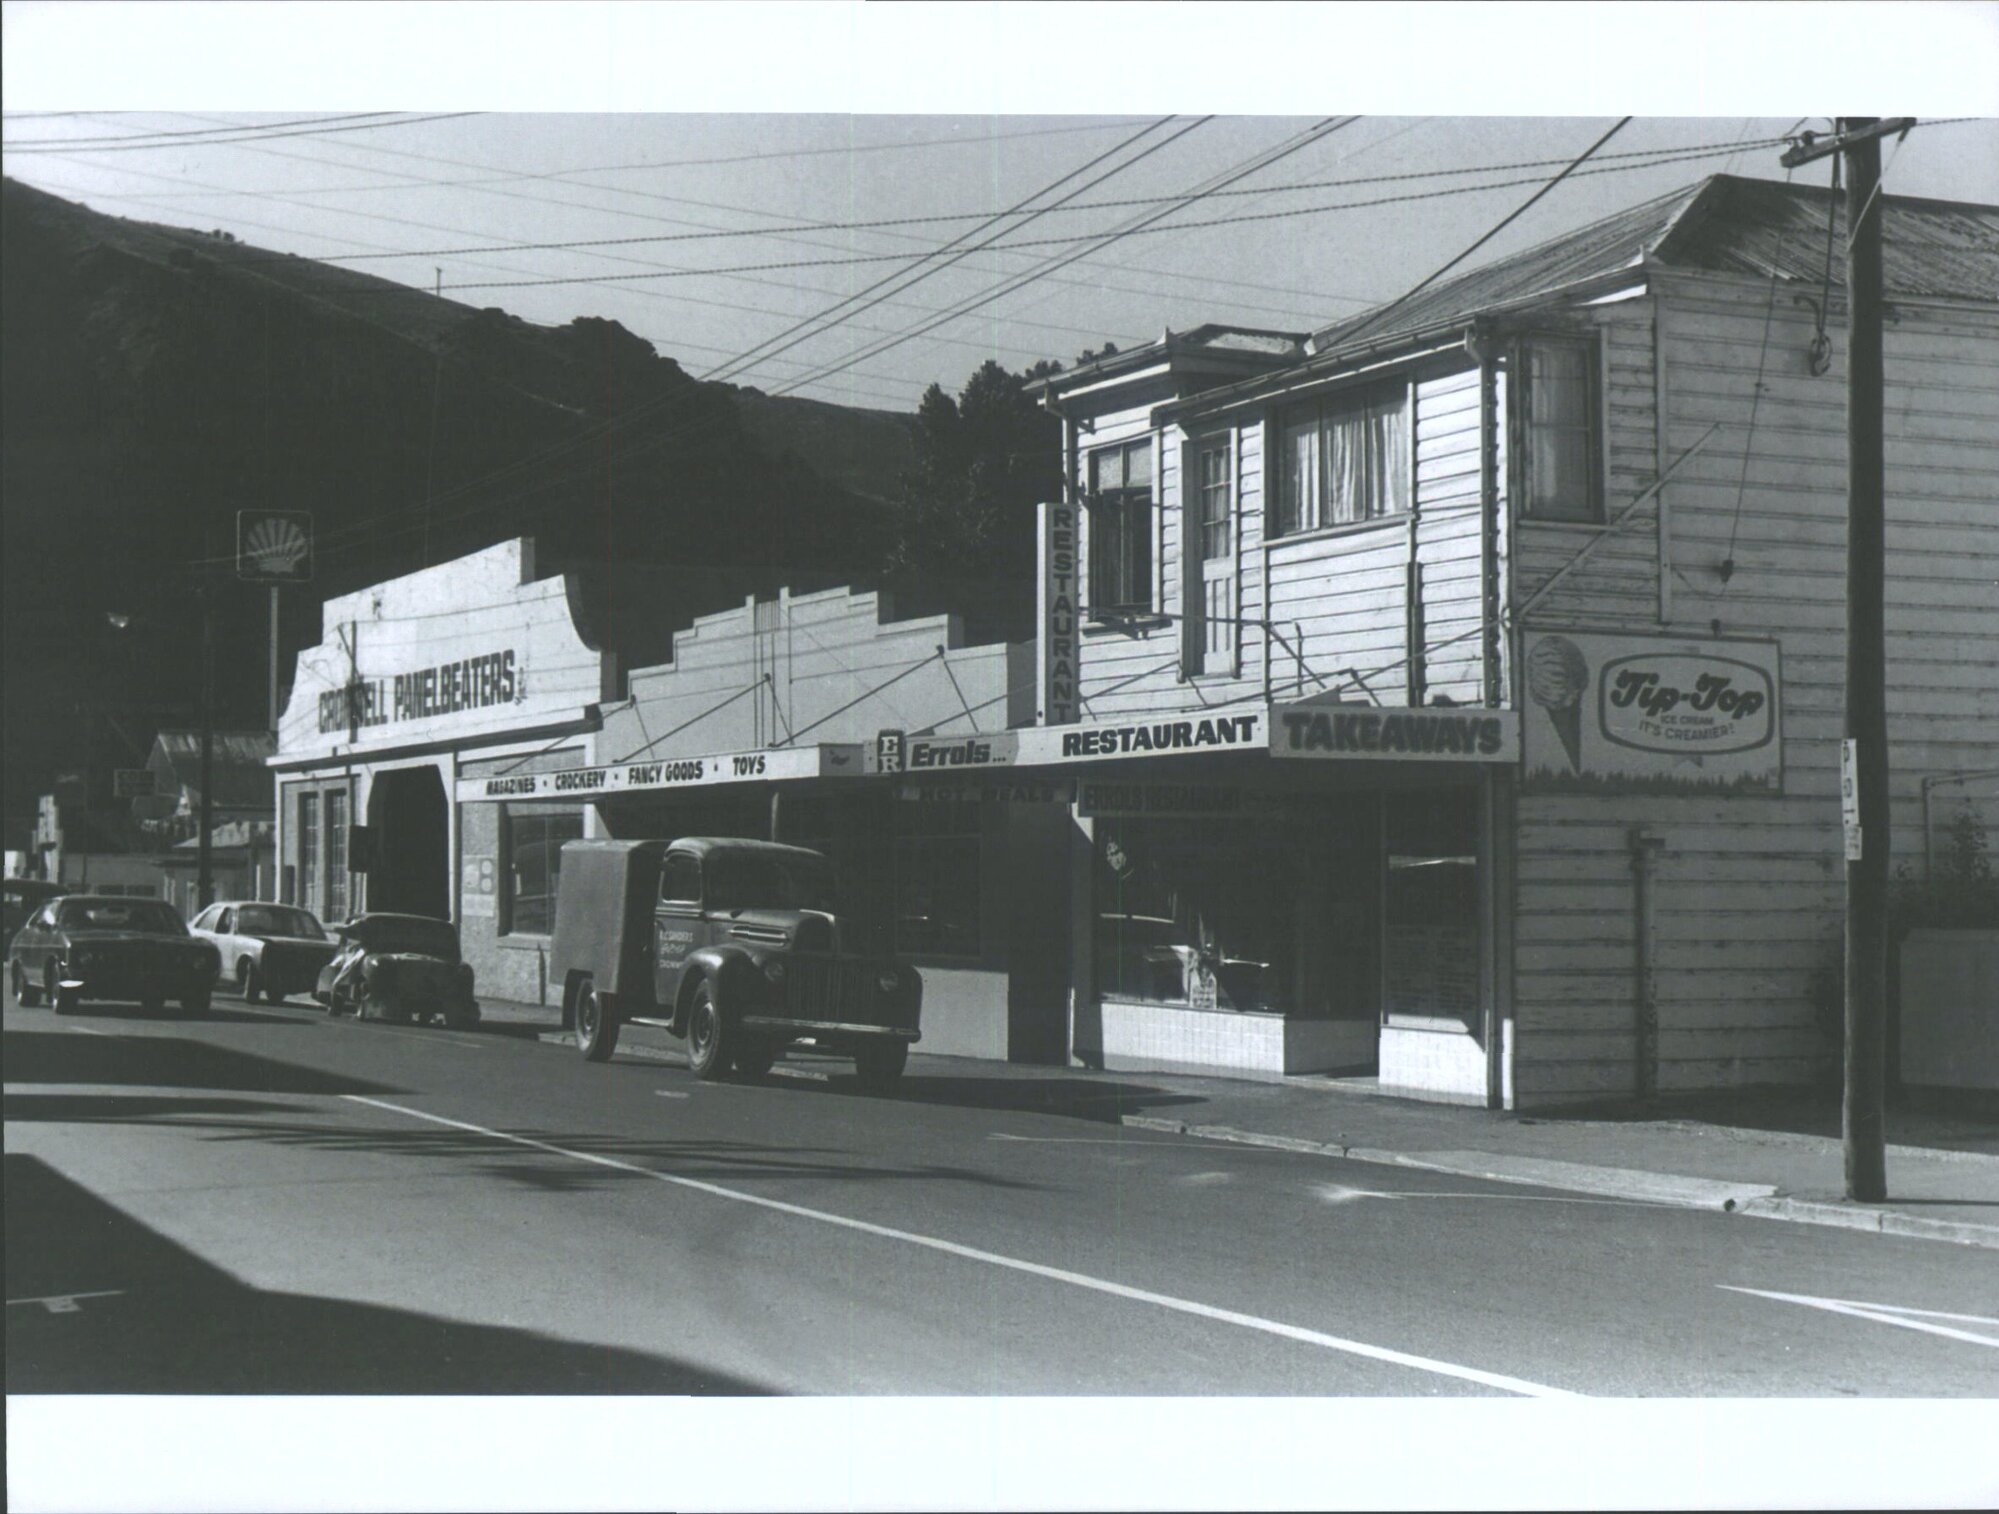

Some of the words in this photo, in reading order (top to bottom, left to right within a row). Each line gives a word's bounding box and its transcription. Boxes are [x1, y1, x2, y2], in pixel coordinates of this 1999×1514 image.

[1053, 508, 1073, 722] RESTAURANT
[319, 680, 388, 734] CROELL
[394, 649, 515, 722] PANELBEATERS
[1610, 669, 1764, 720] Tip-Top
[1063, 715, 1258, 758] RESTAURANT
[1282, 711, 1503, 755] TAKEAWAYS
[1639, 720, 1661, 737] IT'S
[1660, 715, 1677, 725] ICE
[1679, 715, 1715, 725] CREAM
[486, 777, 536, 796] MAGAZINES
[555, 770, 607, 791] CROCKERY
[628, 764, 663, 786] FANCY
[665, 760, 704, 783] GOODS
[733, 754, 767, 777] TOYS
